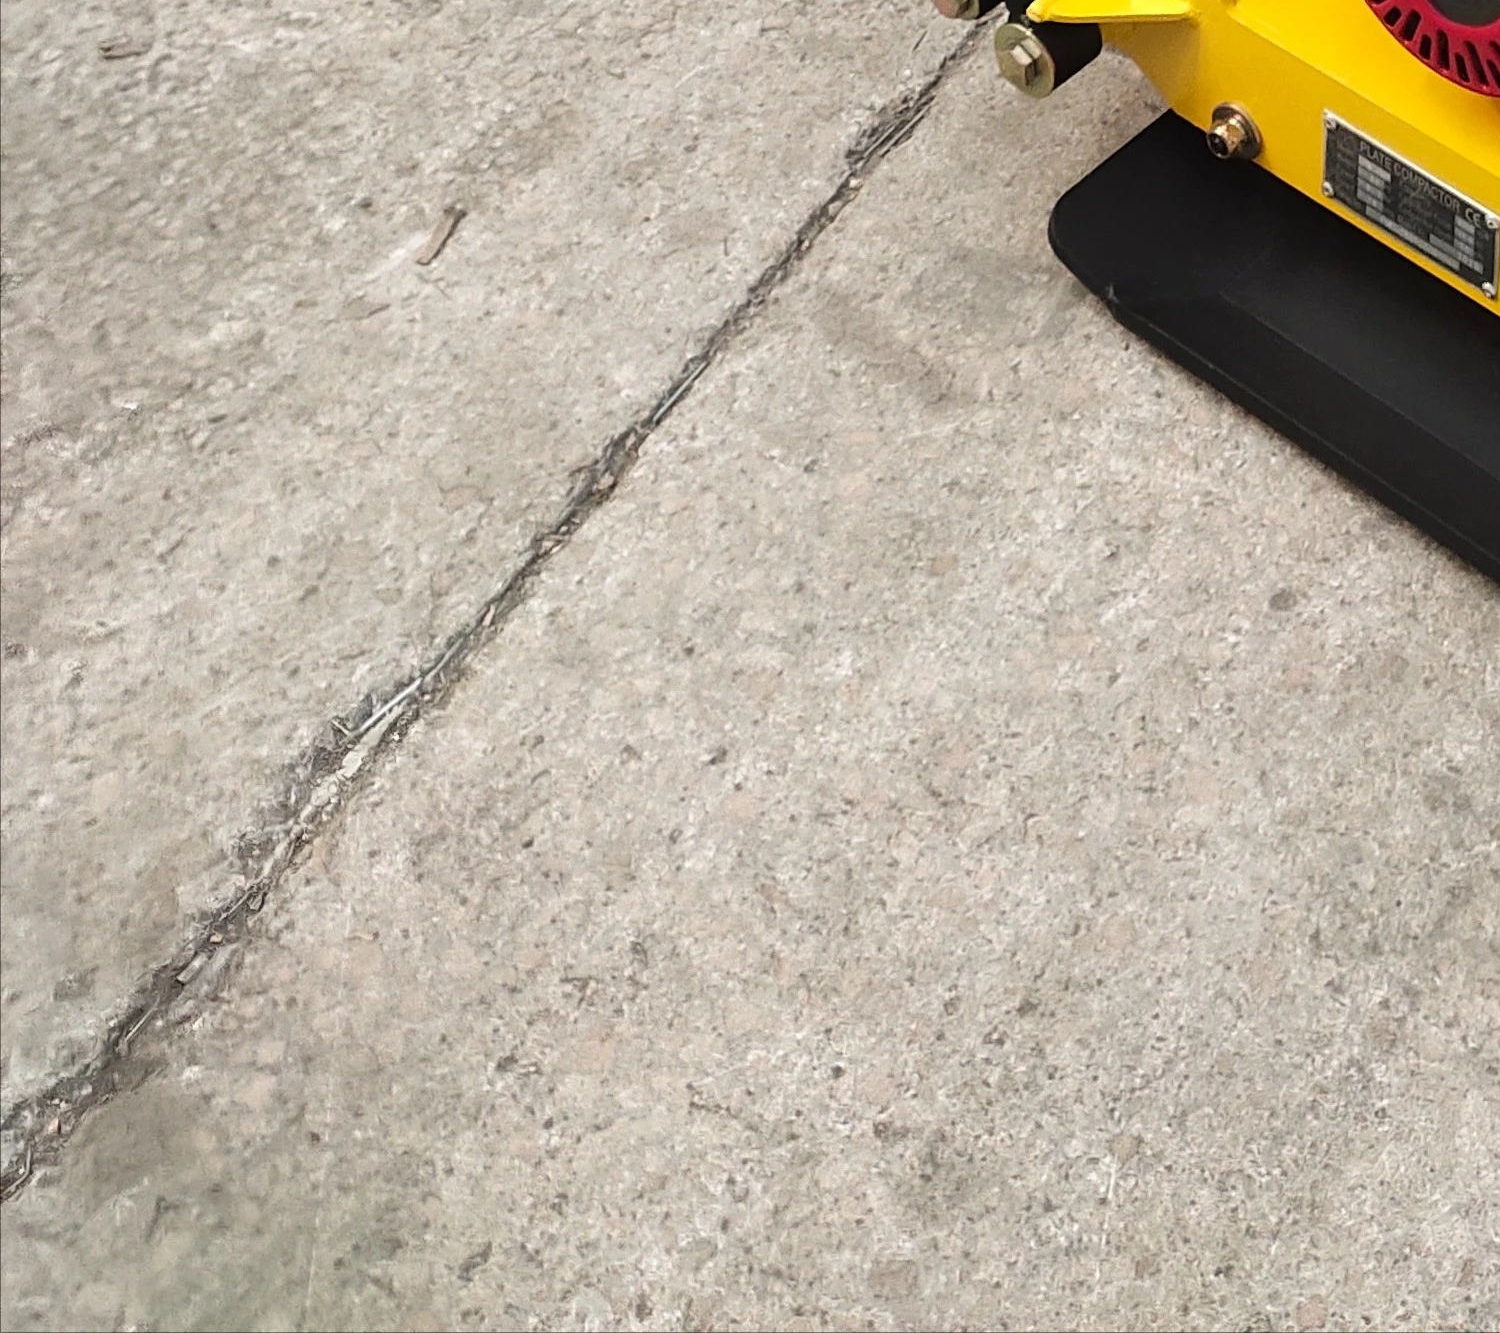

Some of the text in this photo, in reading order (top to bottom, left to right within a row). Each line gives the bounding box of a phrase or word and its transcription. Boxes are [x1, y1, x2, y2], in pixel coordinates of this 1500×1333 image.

[1360, 140, 1482, 228] PLATE COMPACTOR CE
